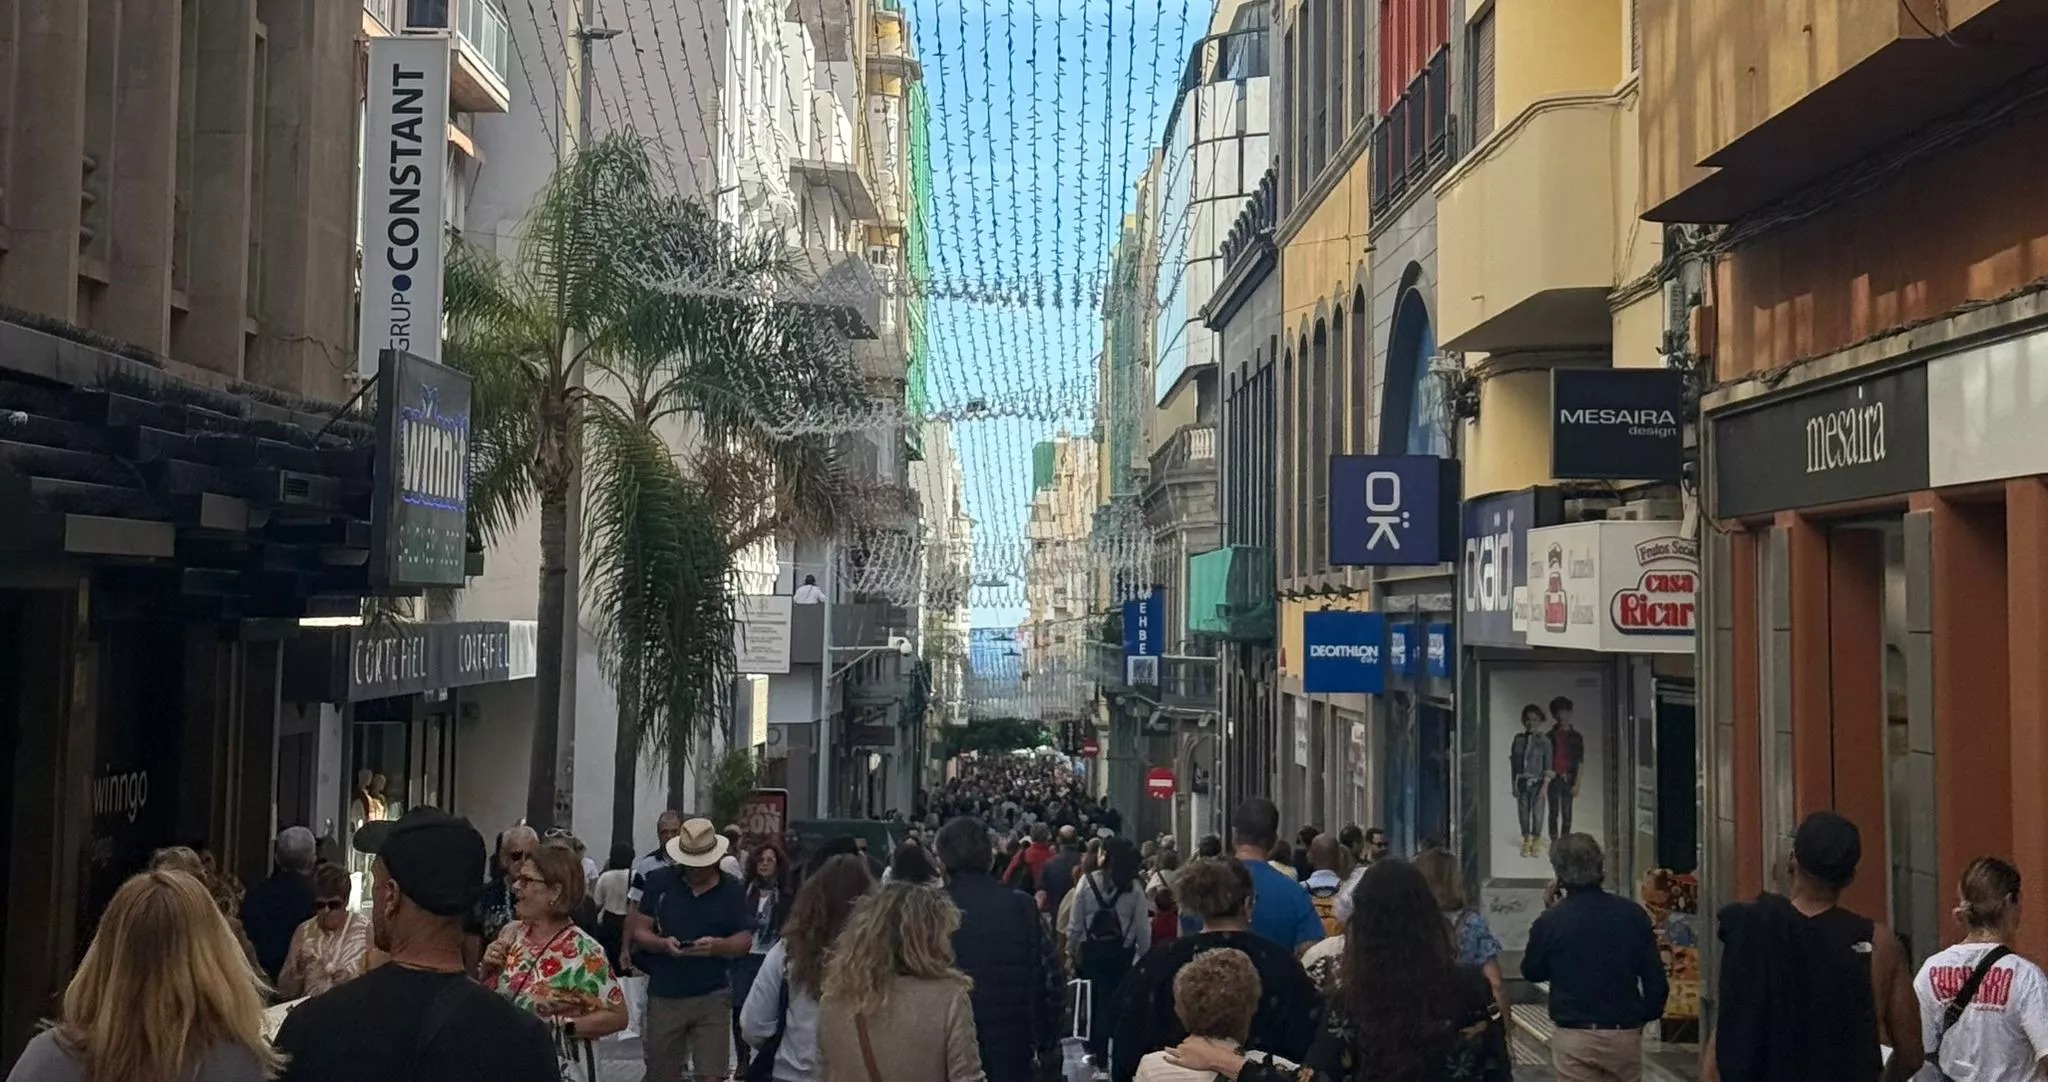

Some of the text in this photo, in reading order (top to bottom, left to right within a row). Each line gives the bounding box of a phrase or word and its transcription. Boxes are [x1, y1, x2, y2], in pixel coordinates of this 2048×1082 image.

[1560, 408, 1676, 425] MESAIRA
[1628, 427, 1677, 438] design
[1806, 385, 1886, 473] mesaira
[1645, 574, 1694, 593] casa
[355, 636, 427, 685] CORTEFIEL
[1310, 645, 1379, 657] DECATHLON
[93, 763, 148, 823] winngo
